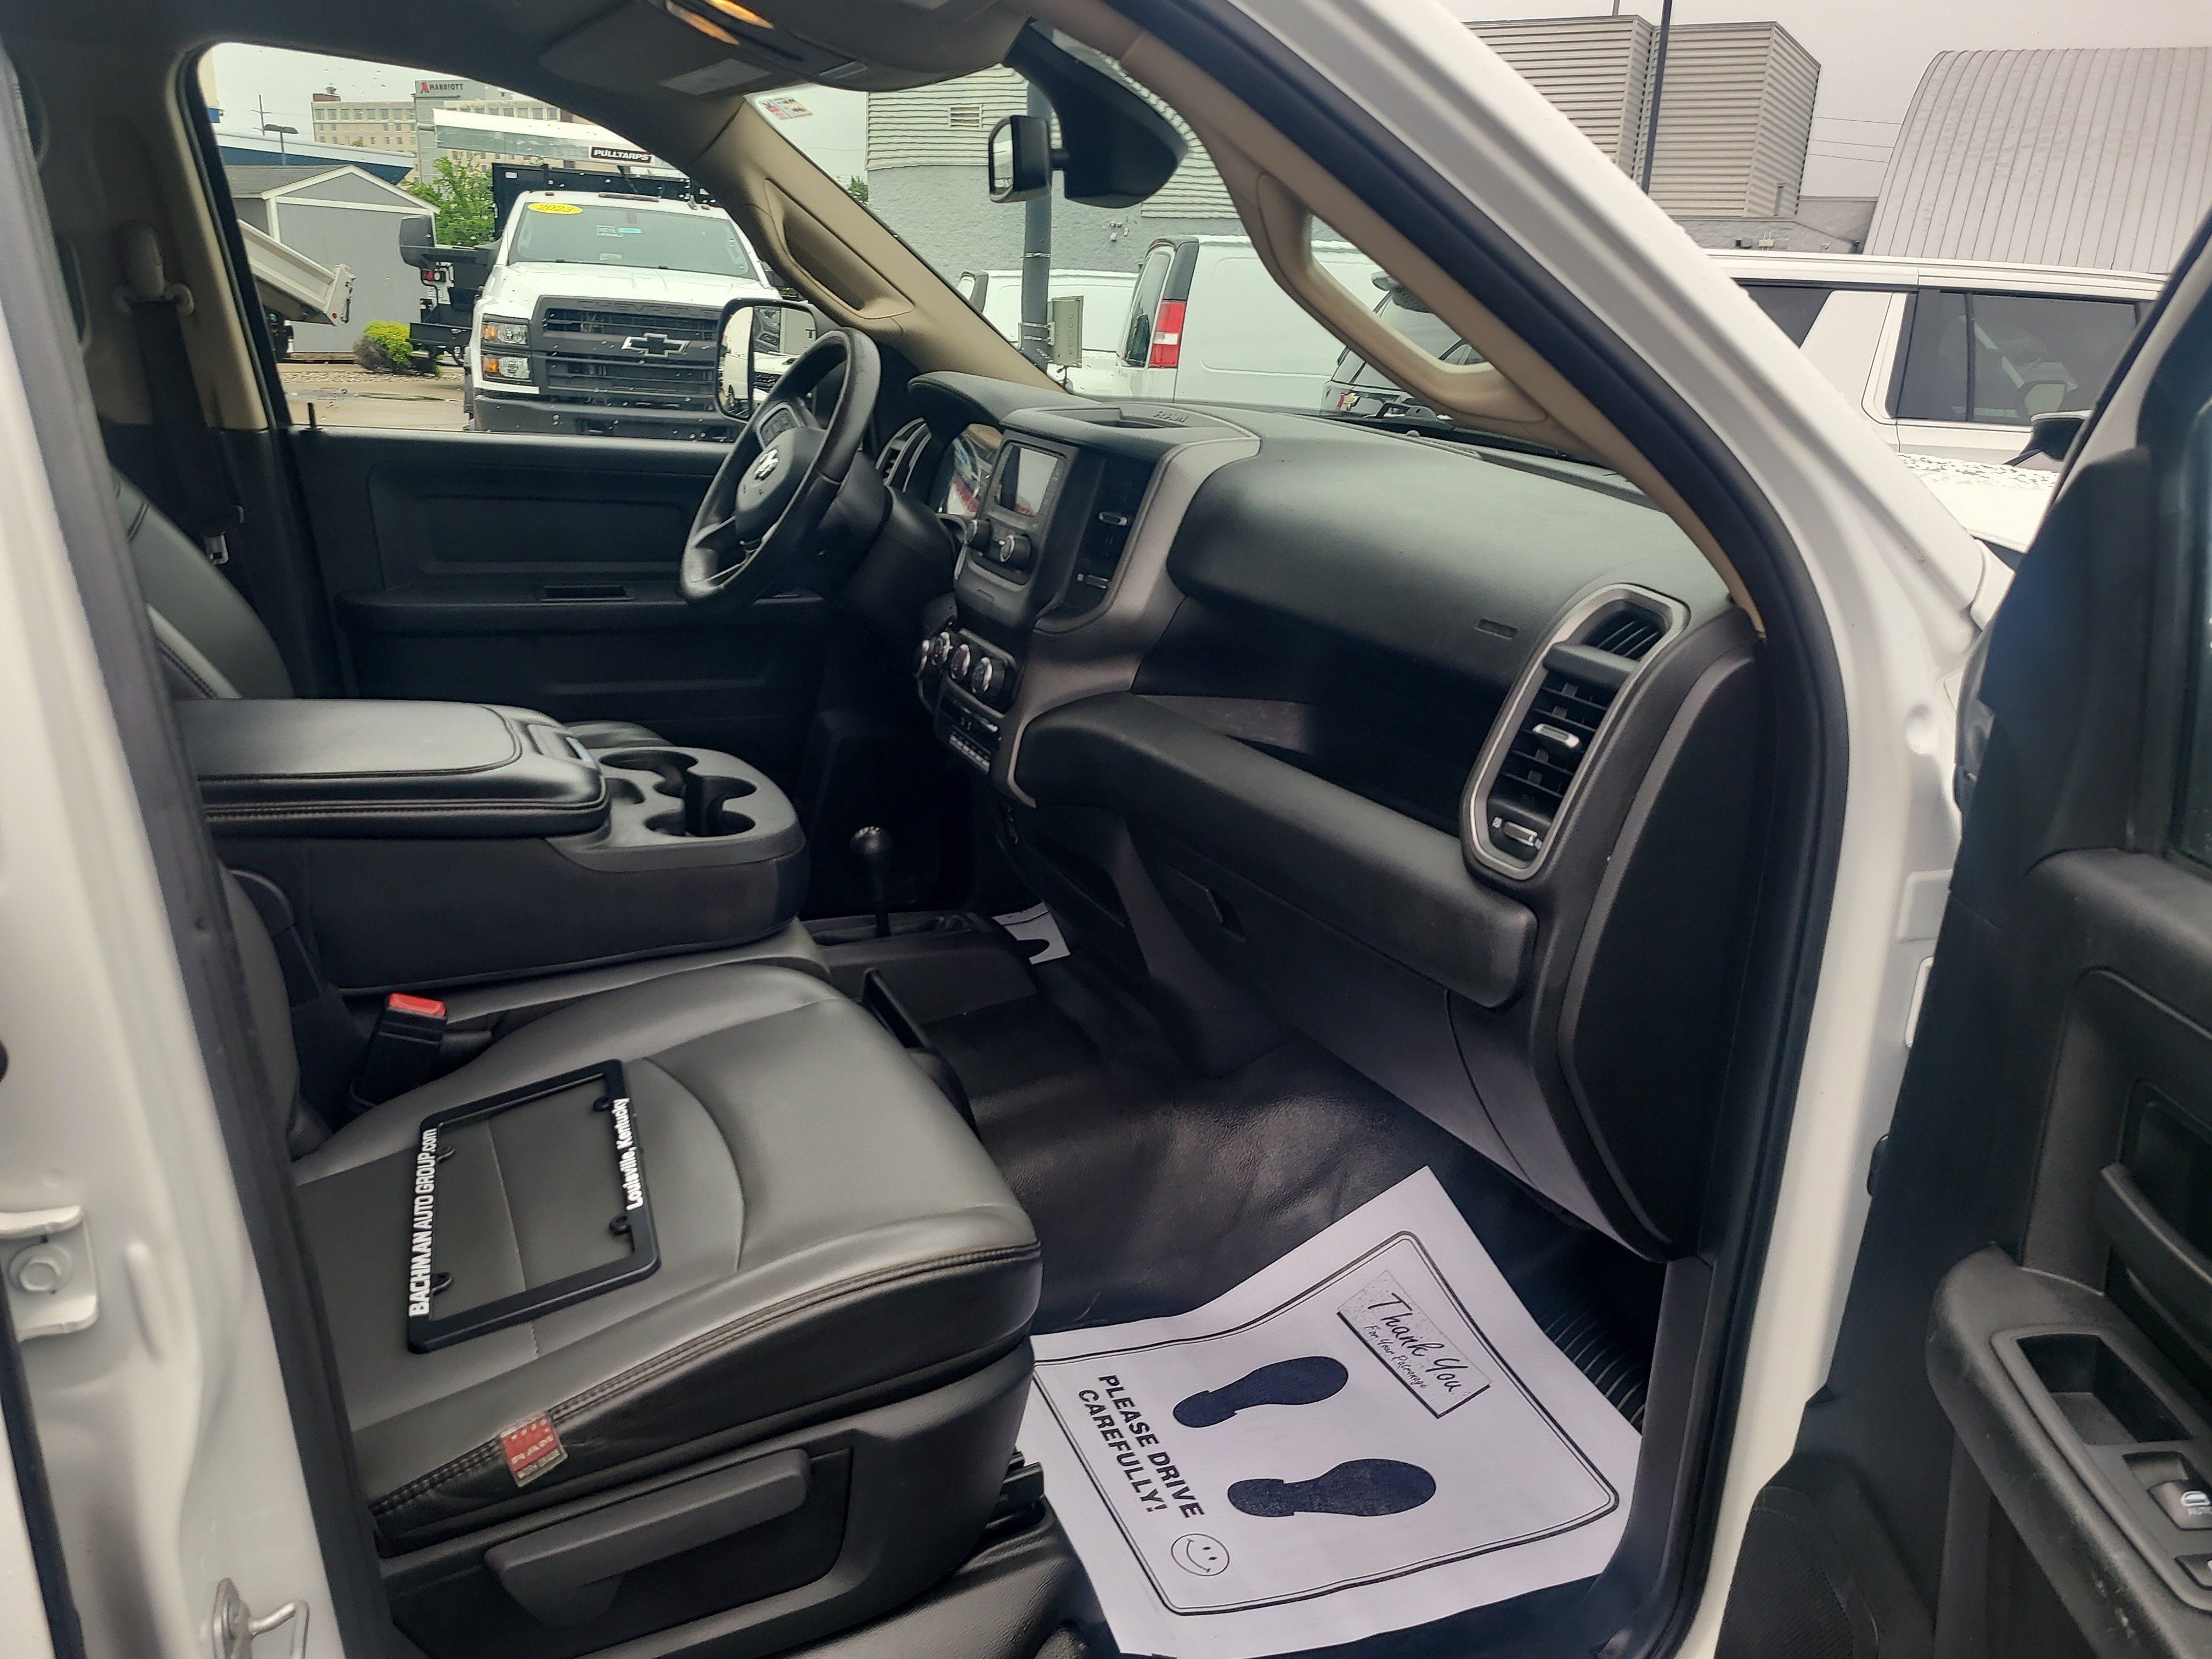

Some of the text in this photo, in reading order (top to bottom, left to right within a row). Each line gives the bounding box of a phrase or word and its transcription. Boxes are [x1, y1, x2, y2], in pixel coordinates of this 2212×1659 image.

[594, 149, 649, 161] PULLTARPS
[537, 204, 574, 212] 2023
[576, 299, 721, 319] CHEVROLE
[1154, 410, 1188, 422] RAM
[612, 1098, 644, 1211] Louisville, Kentucky
[409, 1127, 437, 1317] BACHMAN AUTO GROUP.com
[1364, 1325, 1427, 1389] For Your Patronage
[1368, 1292, 1469, 1393] Thank You
[1079, 1390, 1167, 1513] CAREFULLY!
[1098, 1375, 1205, 1518] PLEASE DRIVE
